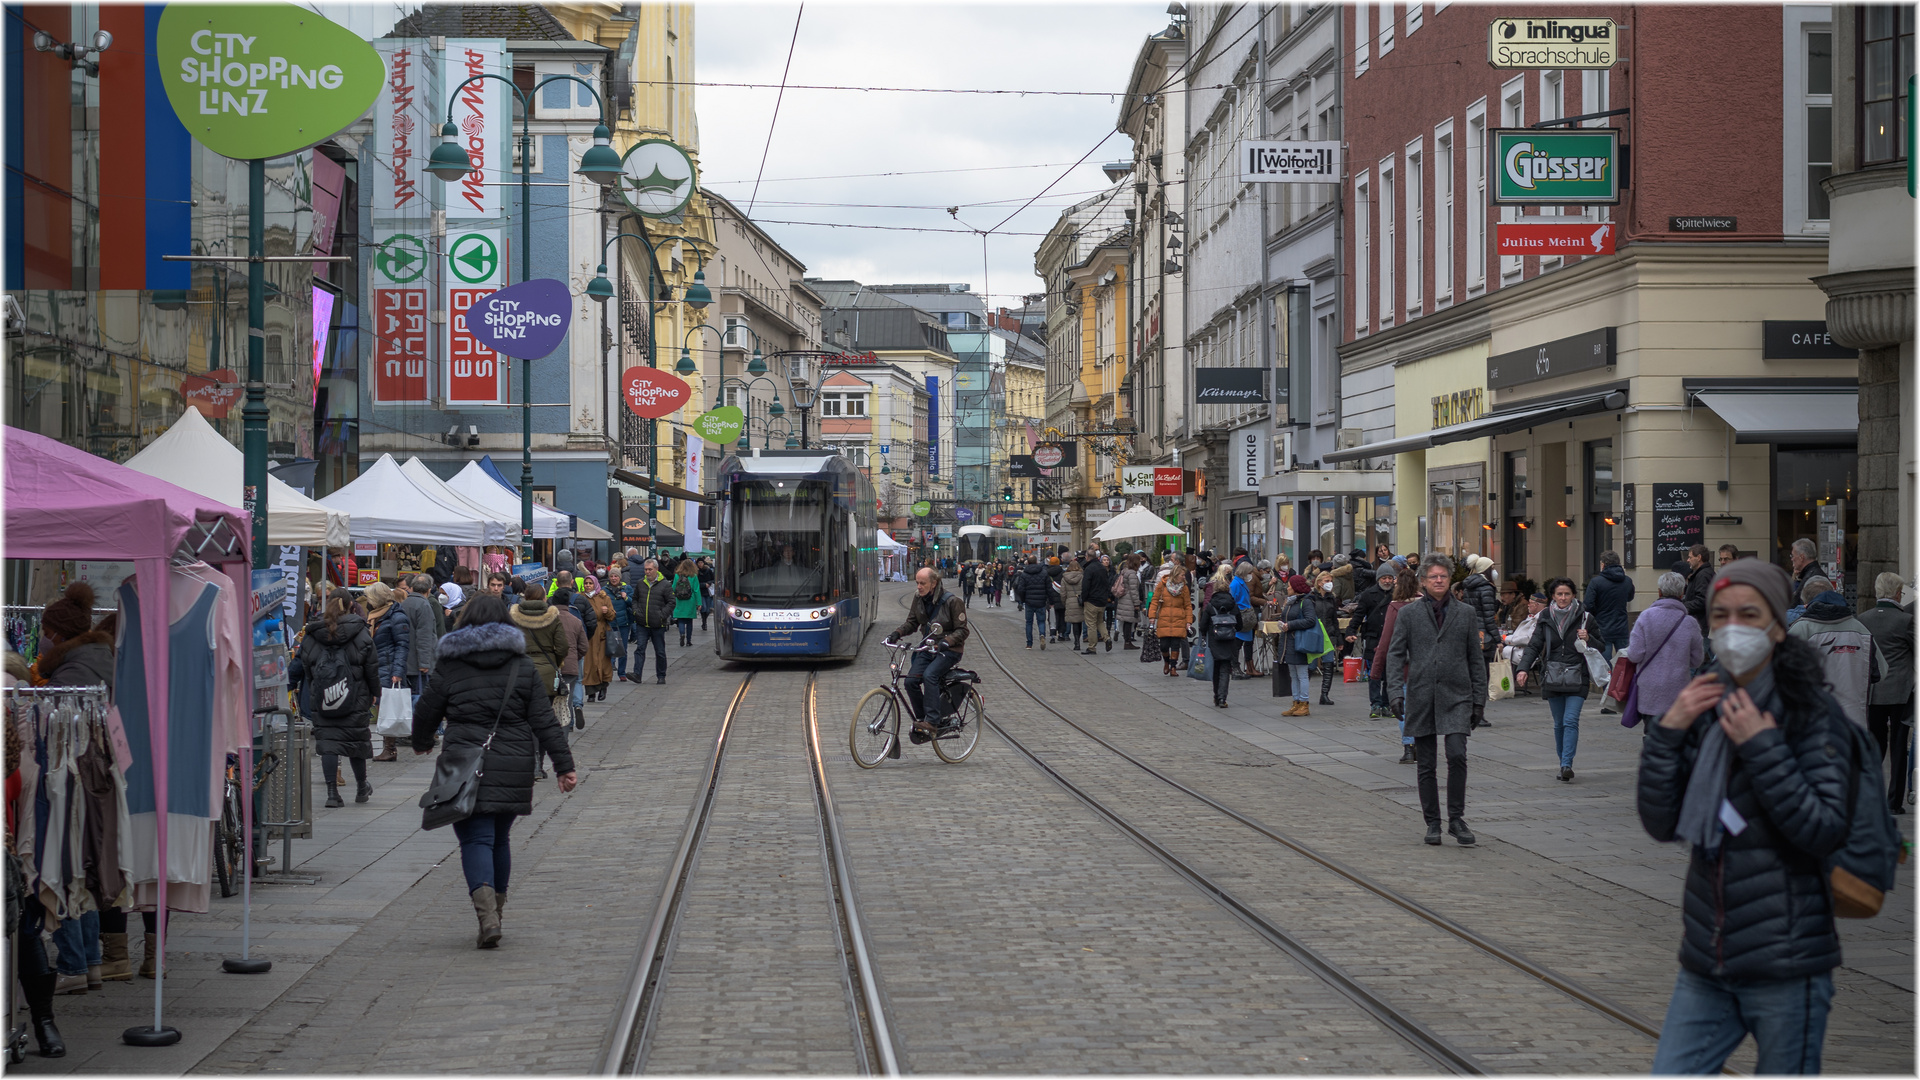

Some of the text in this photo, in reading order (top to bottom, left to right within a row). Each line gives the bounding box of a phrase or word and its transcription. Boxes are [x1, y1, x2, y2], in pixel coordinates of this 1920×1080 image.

[1527, 21, 1609, 43] inlingua
[1498, 46, 1610, 66] Sprachschule
[1264, 155, 1318, 168] Wolford
[1505, 141, 1608, 190] Gösser
[1676, 217, 1731, 230] Spittelwiese
[1502, 238, 1585, 247] Julius Meinl
[1791, 332, 1831, 345] CAFÉ
[1247, 434, 1259, 486] pimkie
[1669, 489, 1688, 498] ECCO
[324, 677, 347, 704] NIKE
